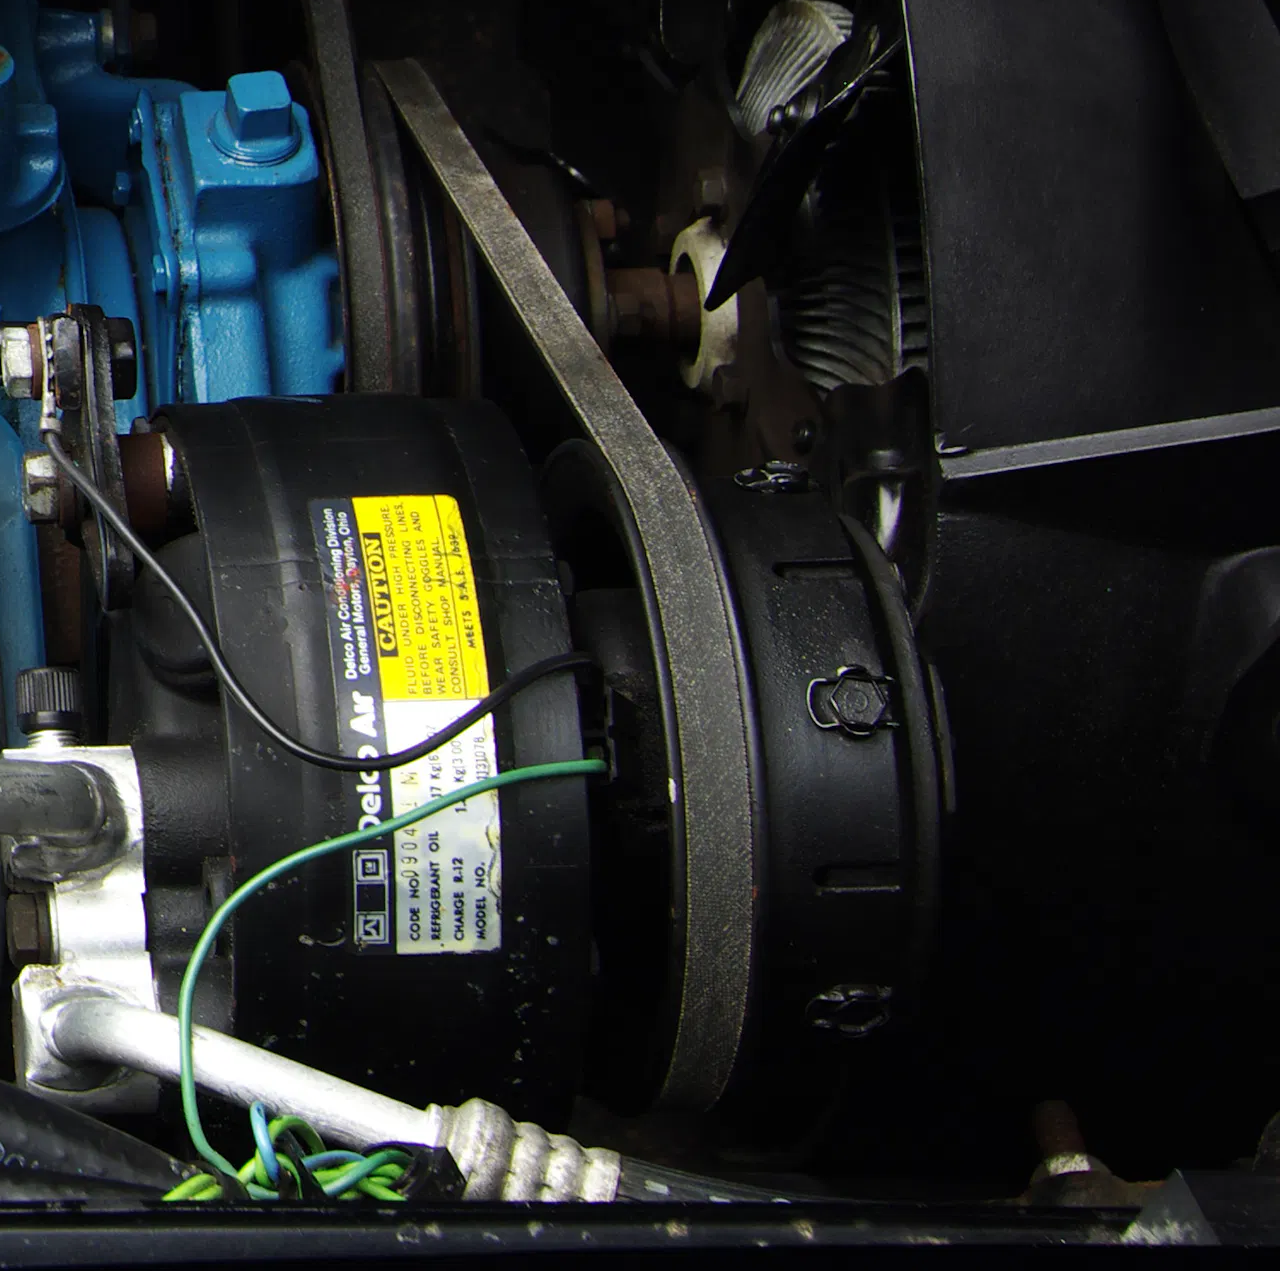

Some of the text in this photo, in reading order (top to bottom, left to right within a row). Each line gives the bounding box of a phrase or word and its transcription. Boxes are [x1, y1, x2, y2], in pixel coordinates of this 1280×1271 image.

[322, 508, 358, 680] Delco Air Conditioning Division
[336, 512, 371, 675] General Motors, Dayton, Ohio
[364, 537, 397, 652] CAUTION
[388, 565, 405, 595] HIGH
[402, 540, 425, 635] DISCONNECTING
[397, 603, 412, 647] UNDER
[410, 511, 446, 695] WEAR SAFETY GOGGLES AND
[439, 594, 452, 626] SHOP
[463, 610, 476, 649] MEETS
[404, 655, 418, 695] FLUID
[418, 644, 432, 695] BEFORE
[445, 634, 462, 694] CONSULT
[350, 690, 377, 737] Air
[428, 830, 439, 853] OIL
[452, 857, 464, 884] R-12
[474, 861, 486, 888] NO.
[429, 860, 441, 941] REFRIGERANT
[453, 891, 465, 941] CHARGE
[475, 896, 487, 940] MODEL
[409, 907, 420, 941] CODE
